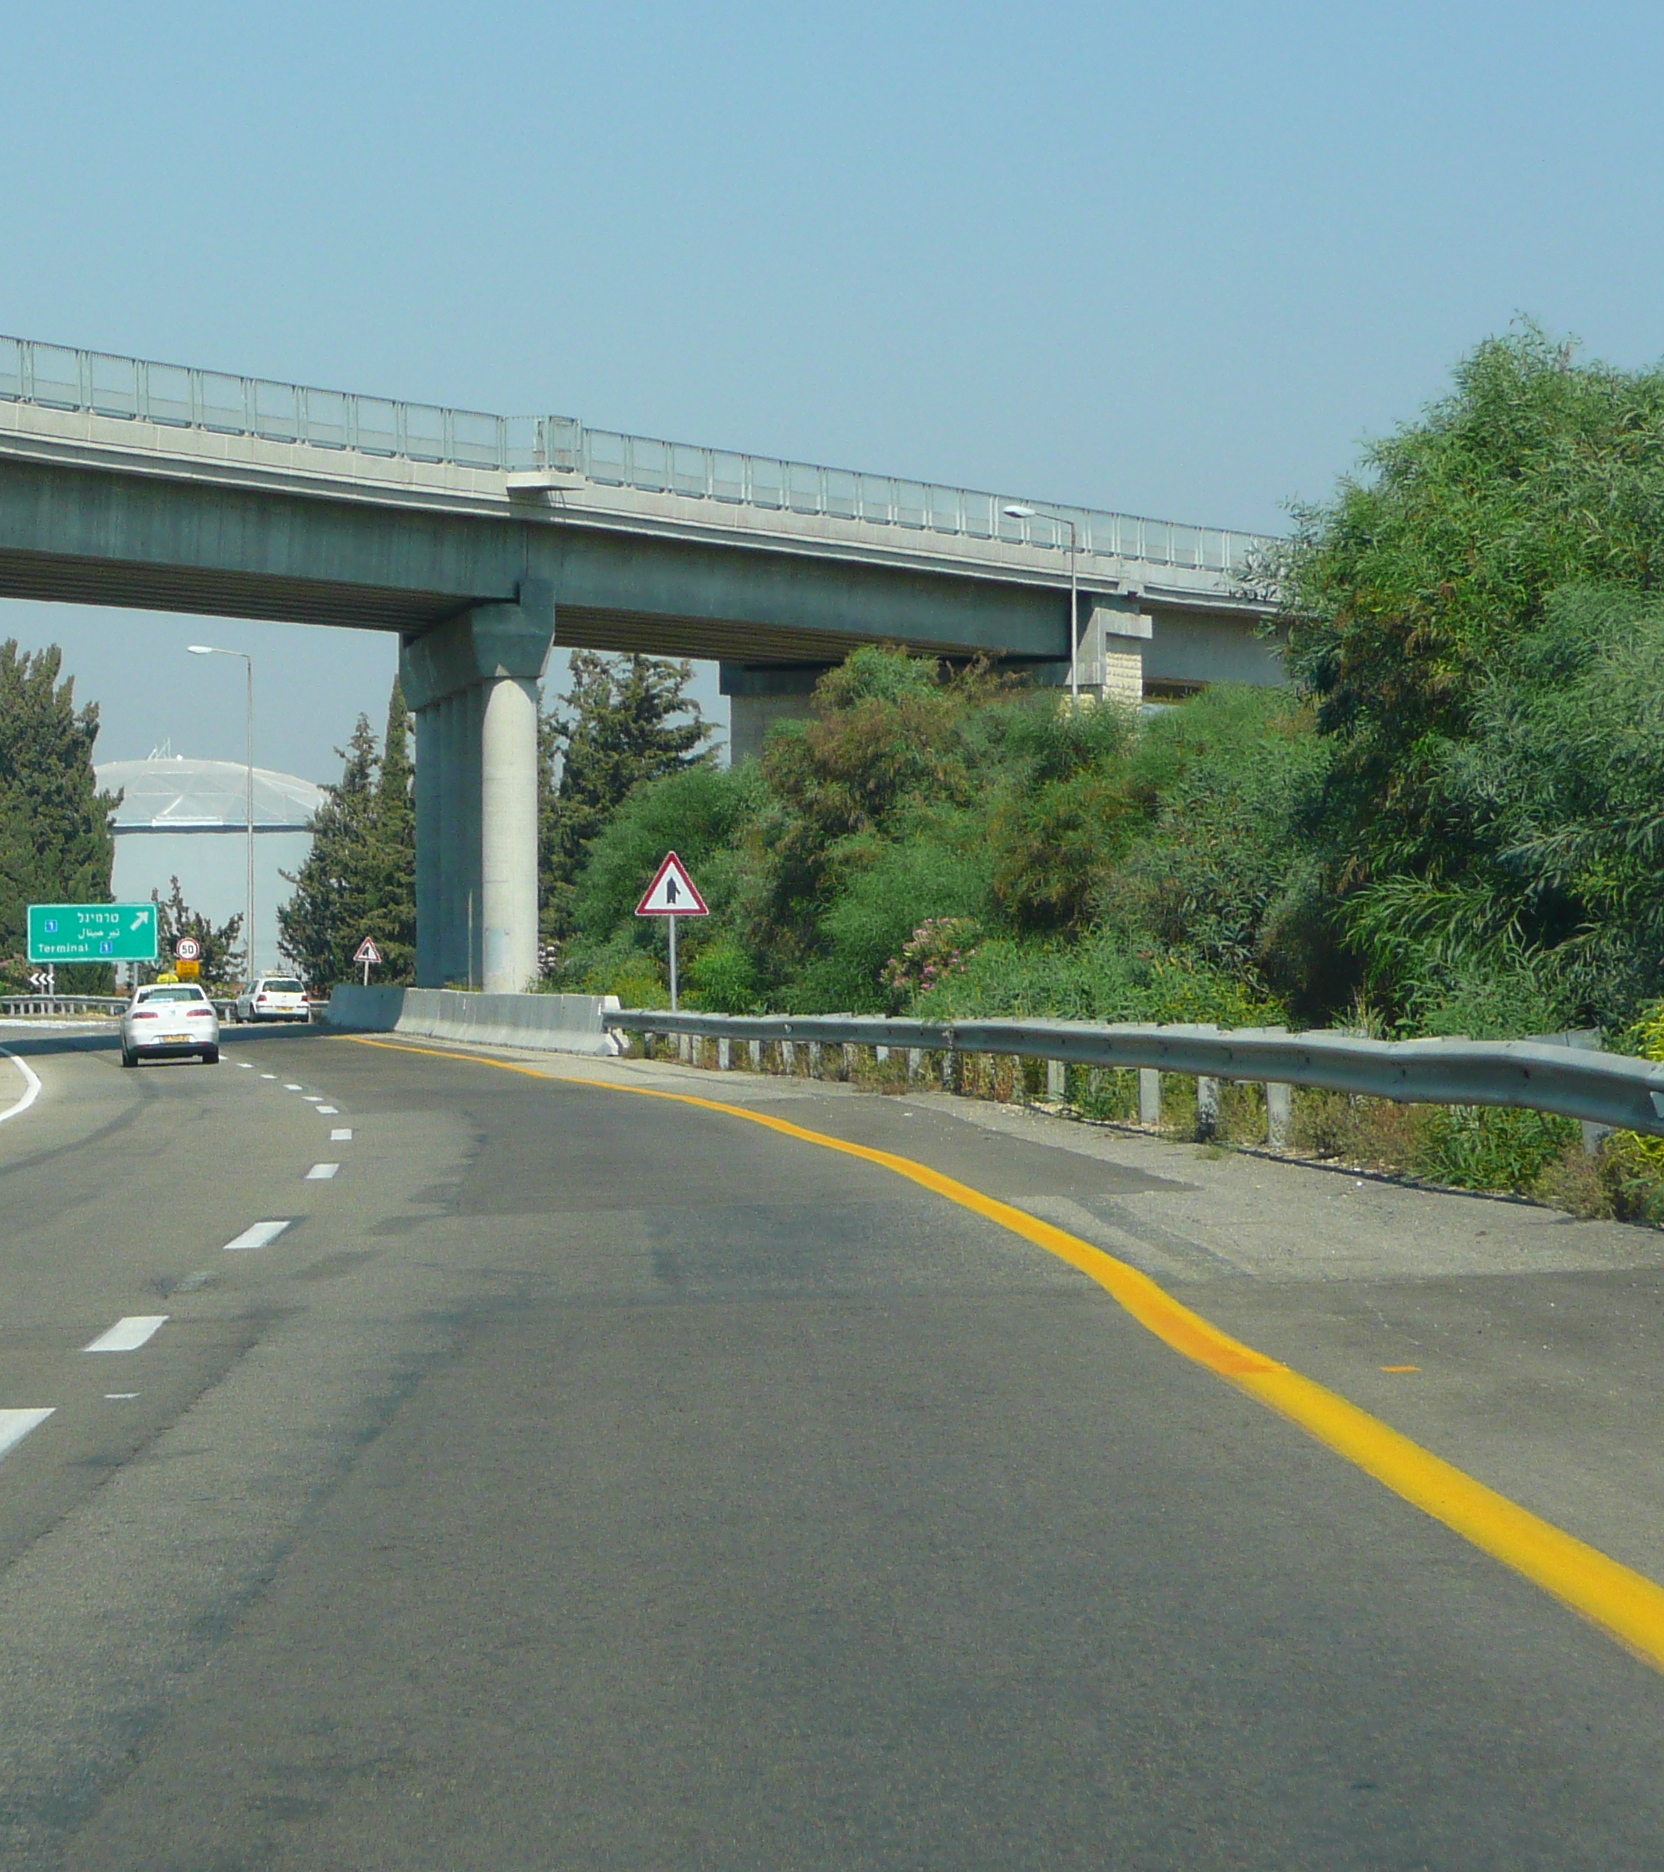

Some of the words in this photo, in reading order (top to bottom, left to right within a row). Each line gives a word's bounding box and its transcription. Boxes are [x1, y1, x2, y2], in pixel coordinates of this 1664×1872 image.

[77, 912, 119, 924] טרמינל
[37, 942, 89, 953] Terminal
[182, 945, 194, 954] 50
